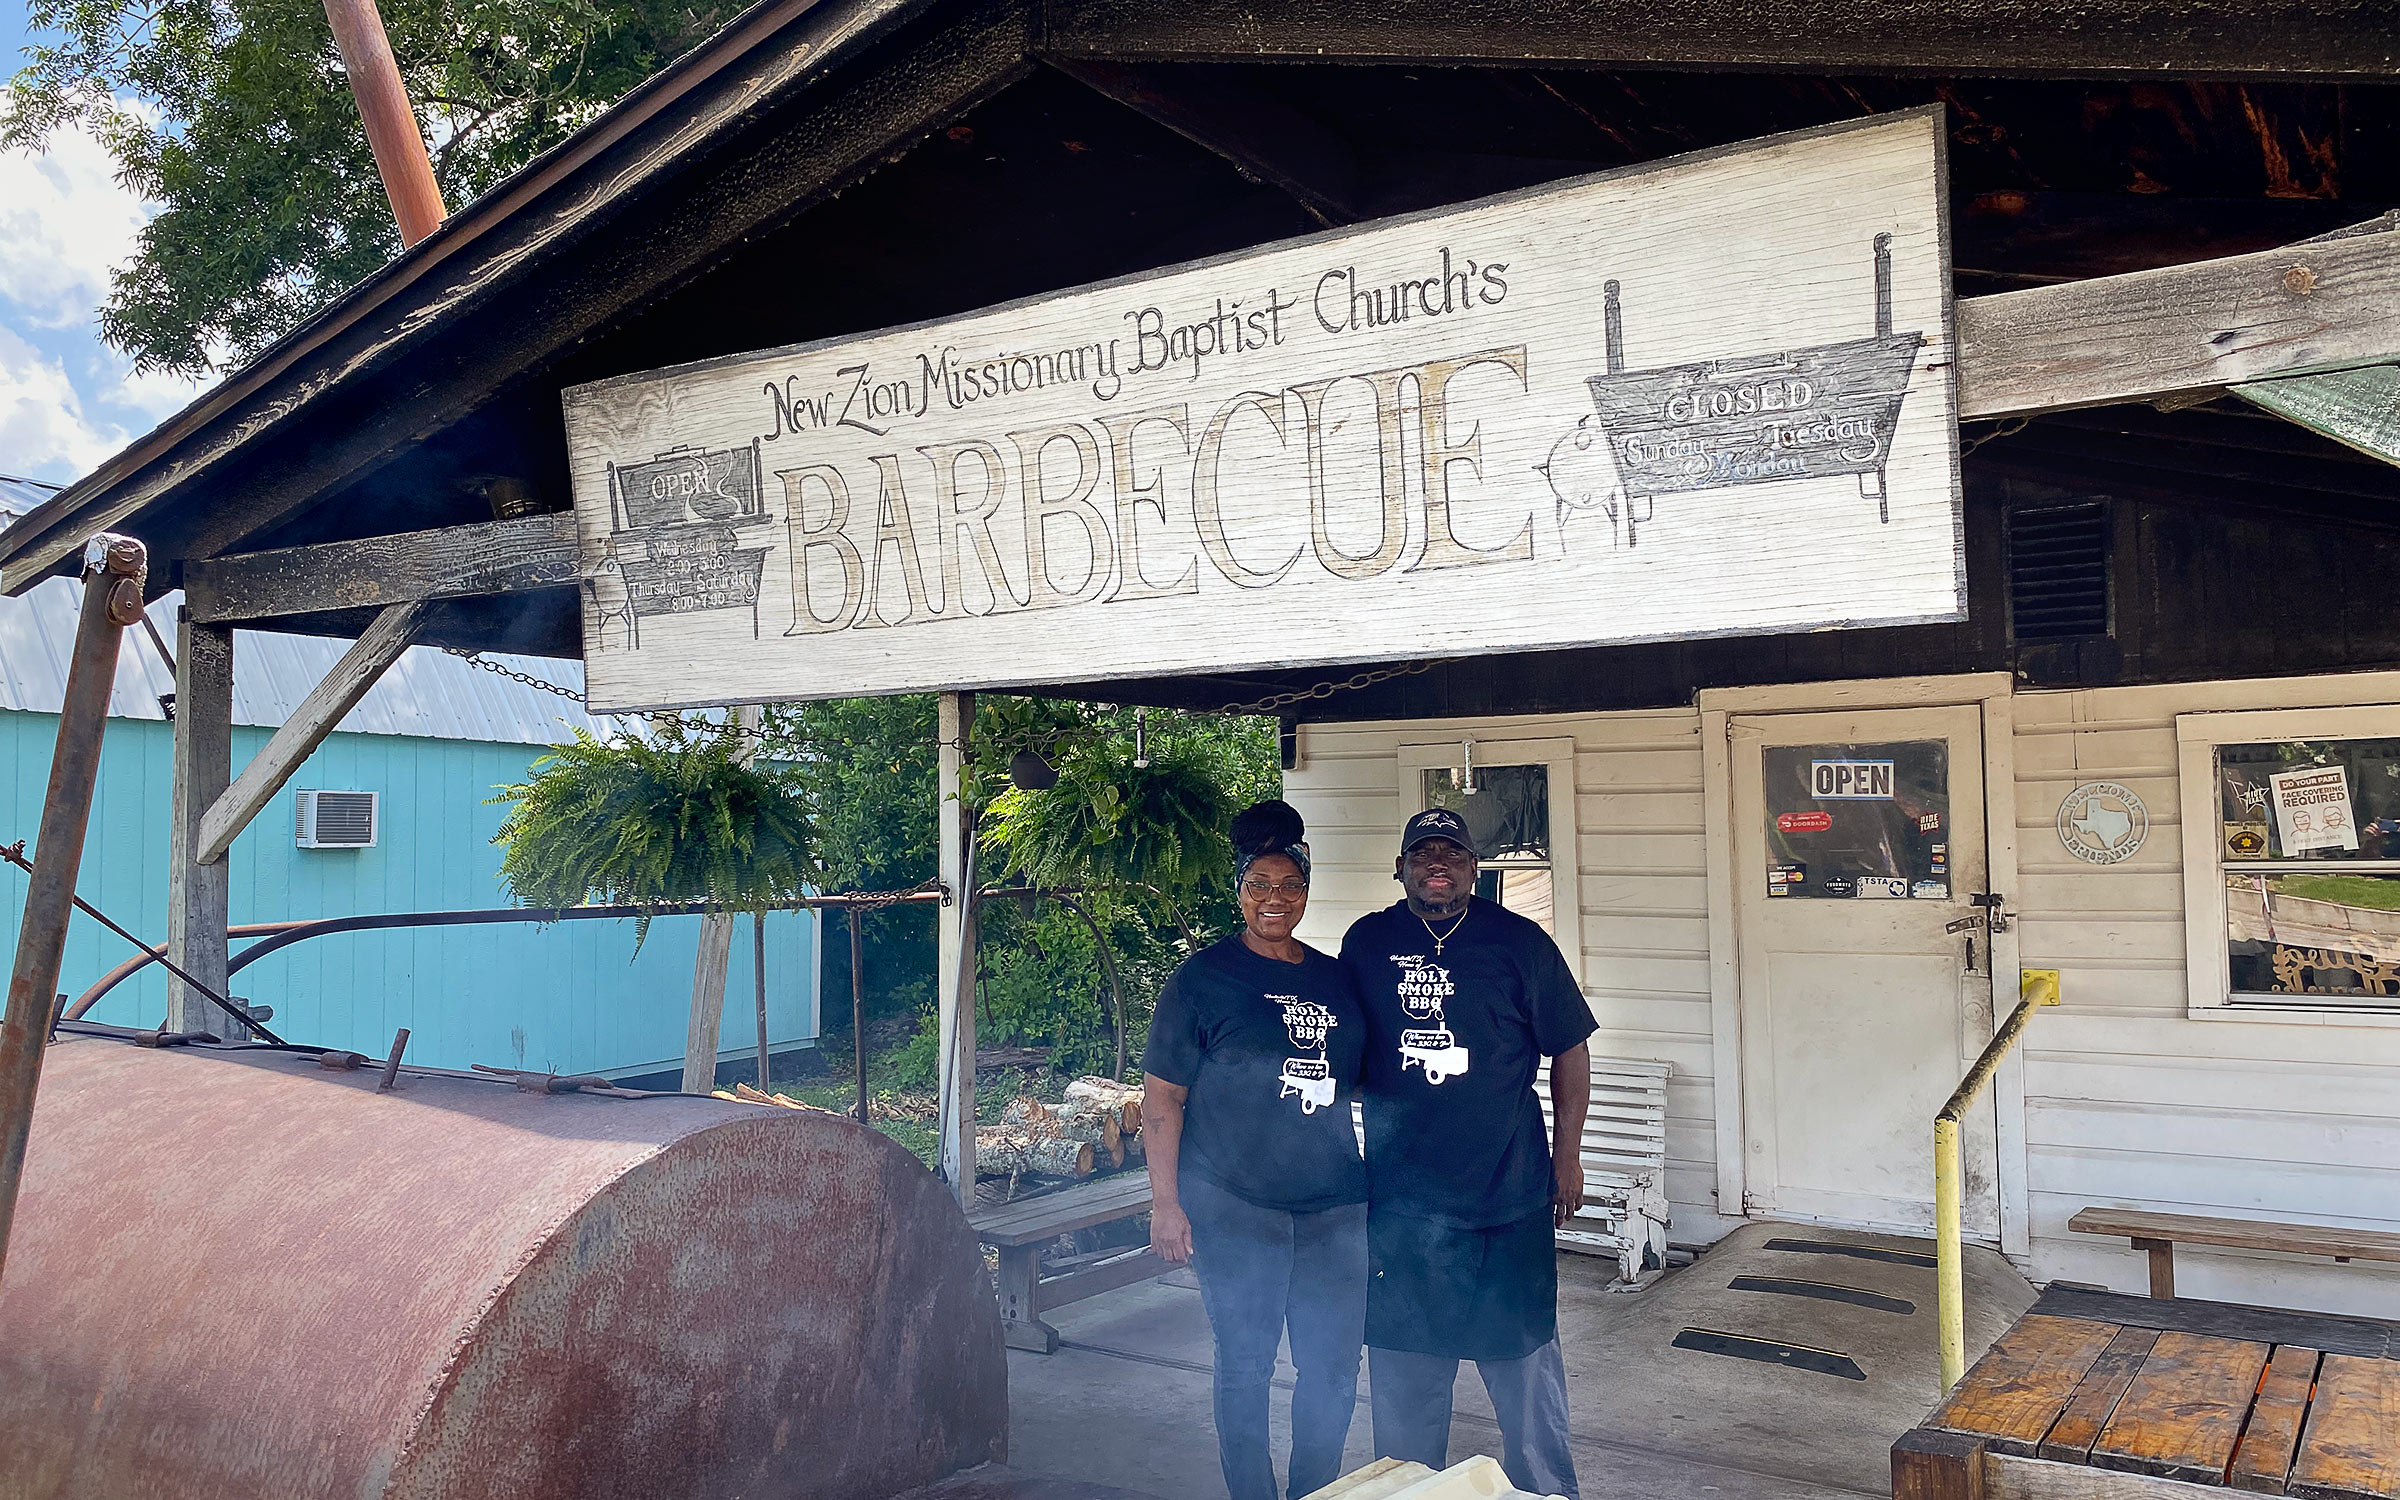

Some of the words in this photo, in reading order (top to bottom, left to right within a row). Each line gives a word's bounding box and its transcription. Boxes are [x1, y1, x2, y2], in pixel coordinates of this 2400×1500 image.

[764, 374, 834, 440] New
[836, 362, 914, 436] Zion
[915, 339, 1120, 400] Missionary
[1124, 288, 1299, 382] Baptist
[1315, 246, 1511, 333] Church's
[1667, 382, 1813, 421] CLOSED
[1626, 436, 1714, 478] Sunday
[1763, 413, 1880, 462] Tuesday
[652, 469, 711, 499] OPEN
[774, 344, 1535, 636] BARBECUE
[1816, 765, 1889, 794] OPEN
[2318, 775, 2338, 784] PART
[2281, 790, 2301, 799] FACE
[2302, 786, 2344, 796] COVERING
[2283, 792, 2346, 808] REQUIRED
[1920, 820, 1939, 831] TEXAS
[2067, 840, 2140, 861] FRIENDS
[1864, 877, 1888, 885] TSTA
[1403, 969, 1450, 983] HOLY
[1397, 982, 1455, 996] SMOKE
[1284, 1004, 1328, 1016] HOLY
[1408, 996, 1441, 1010] BBQ
[1282, 1013, 1338, 1027] SMOKE
[1295, 1026, 1327, 1040] BBQ
